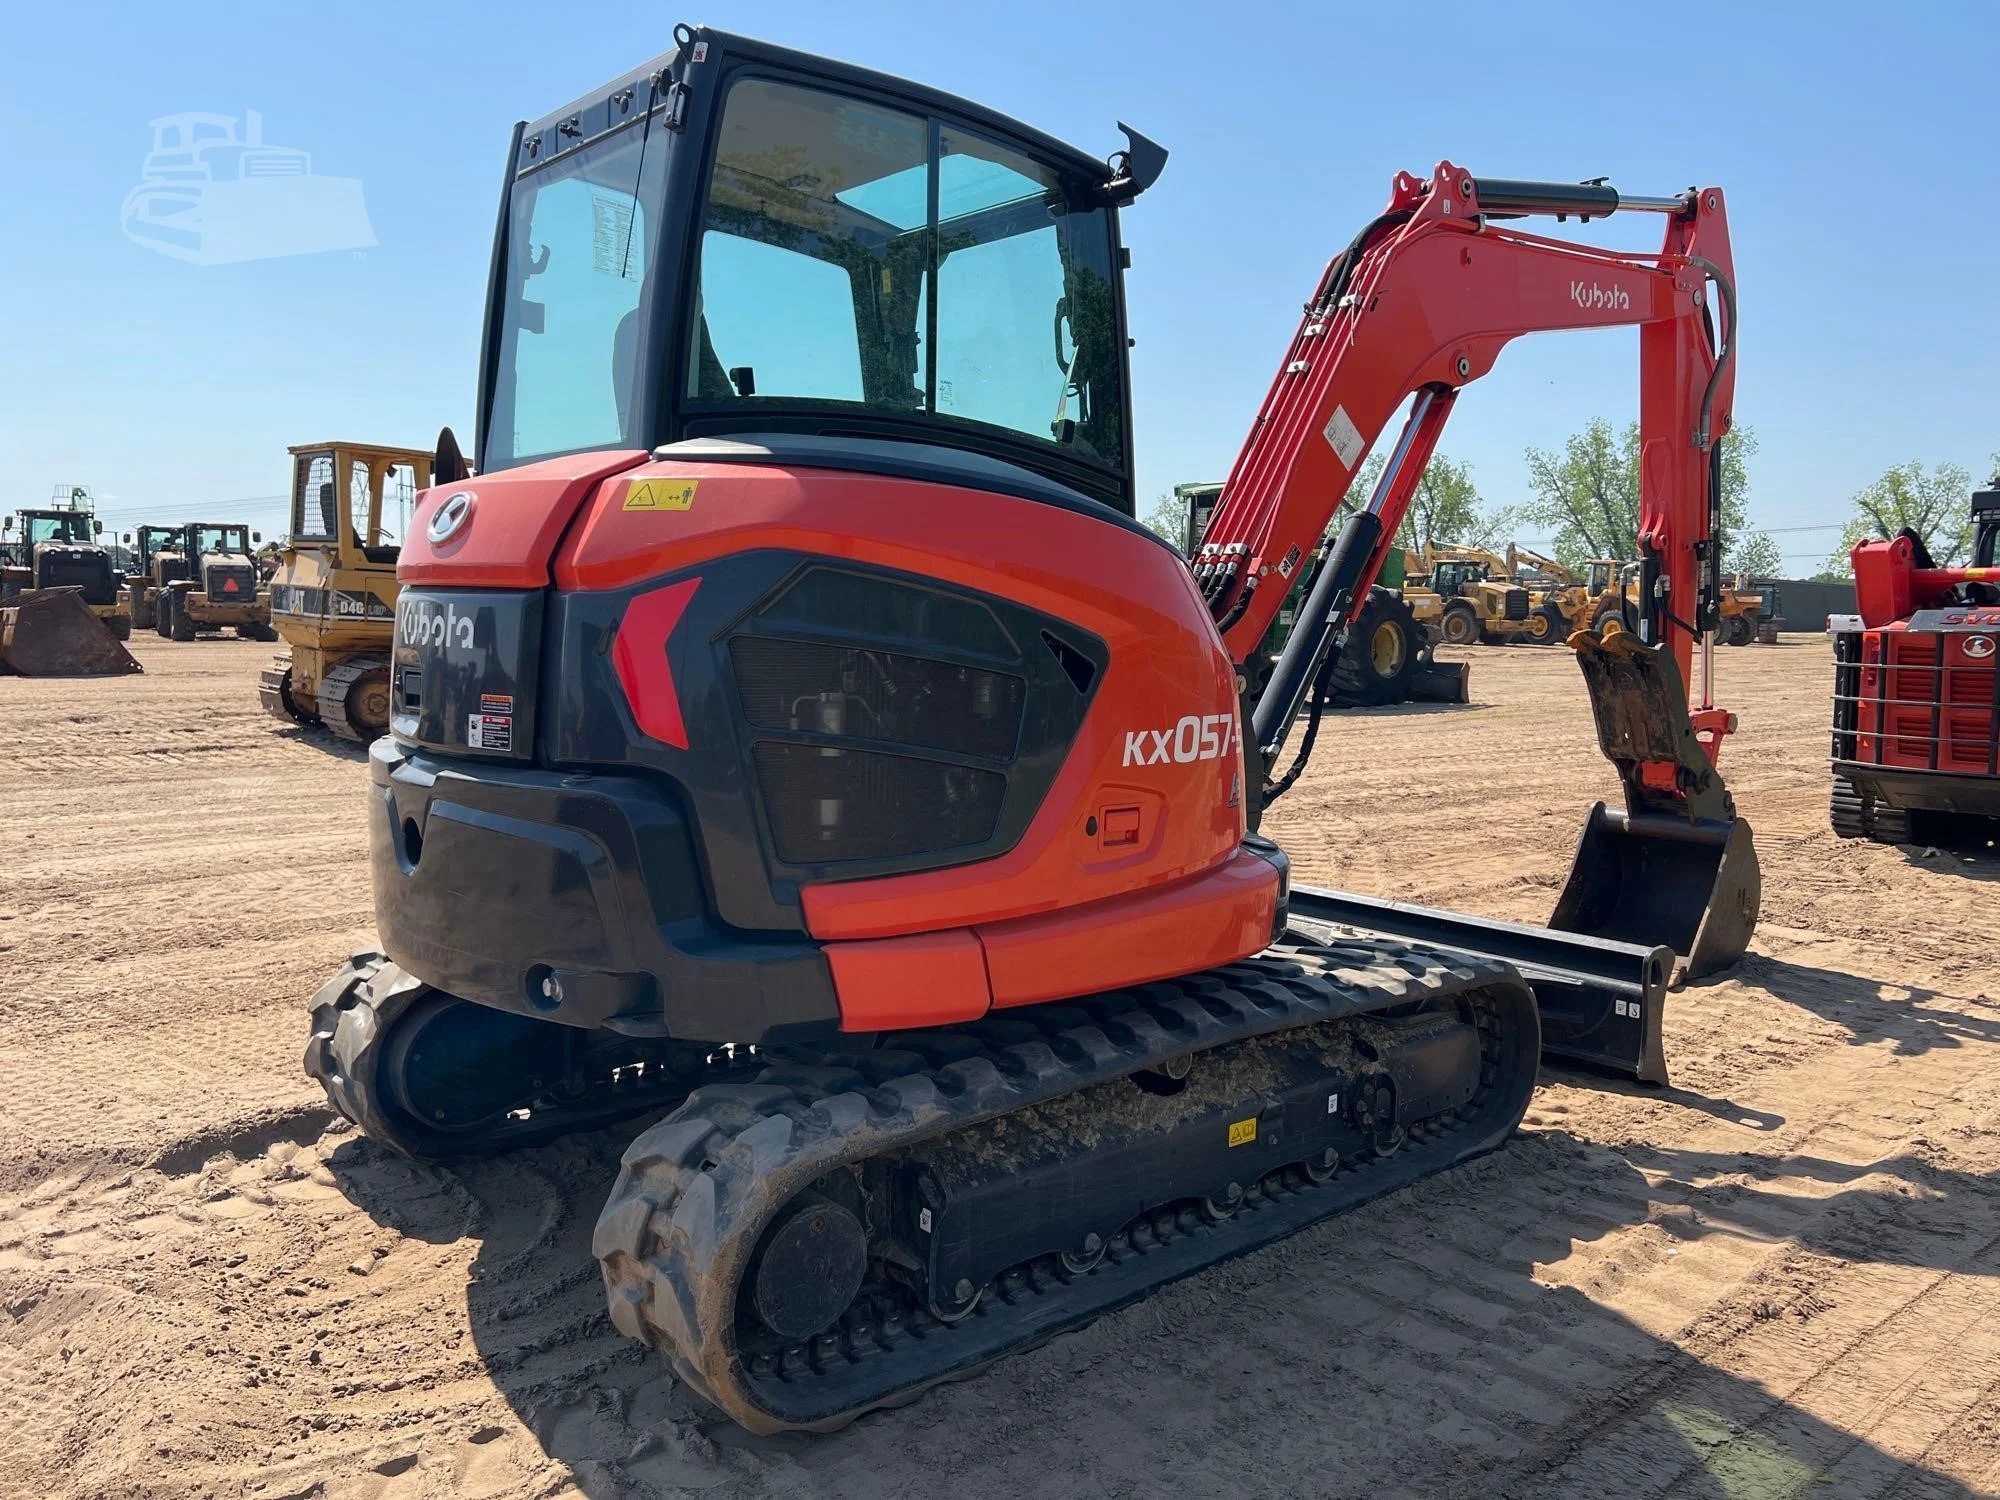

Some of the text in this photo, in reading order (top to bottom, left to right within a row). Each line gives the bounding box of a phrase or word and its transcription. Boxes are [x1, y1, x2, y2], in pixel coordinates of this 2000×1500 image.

[1570, 280, 1630, 310] Kubota
[339, 601, 365, 614] D4G
[400, 602, 475, 649] Kubota
